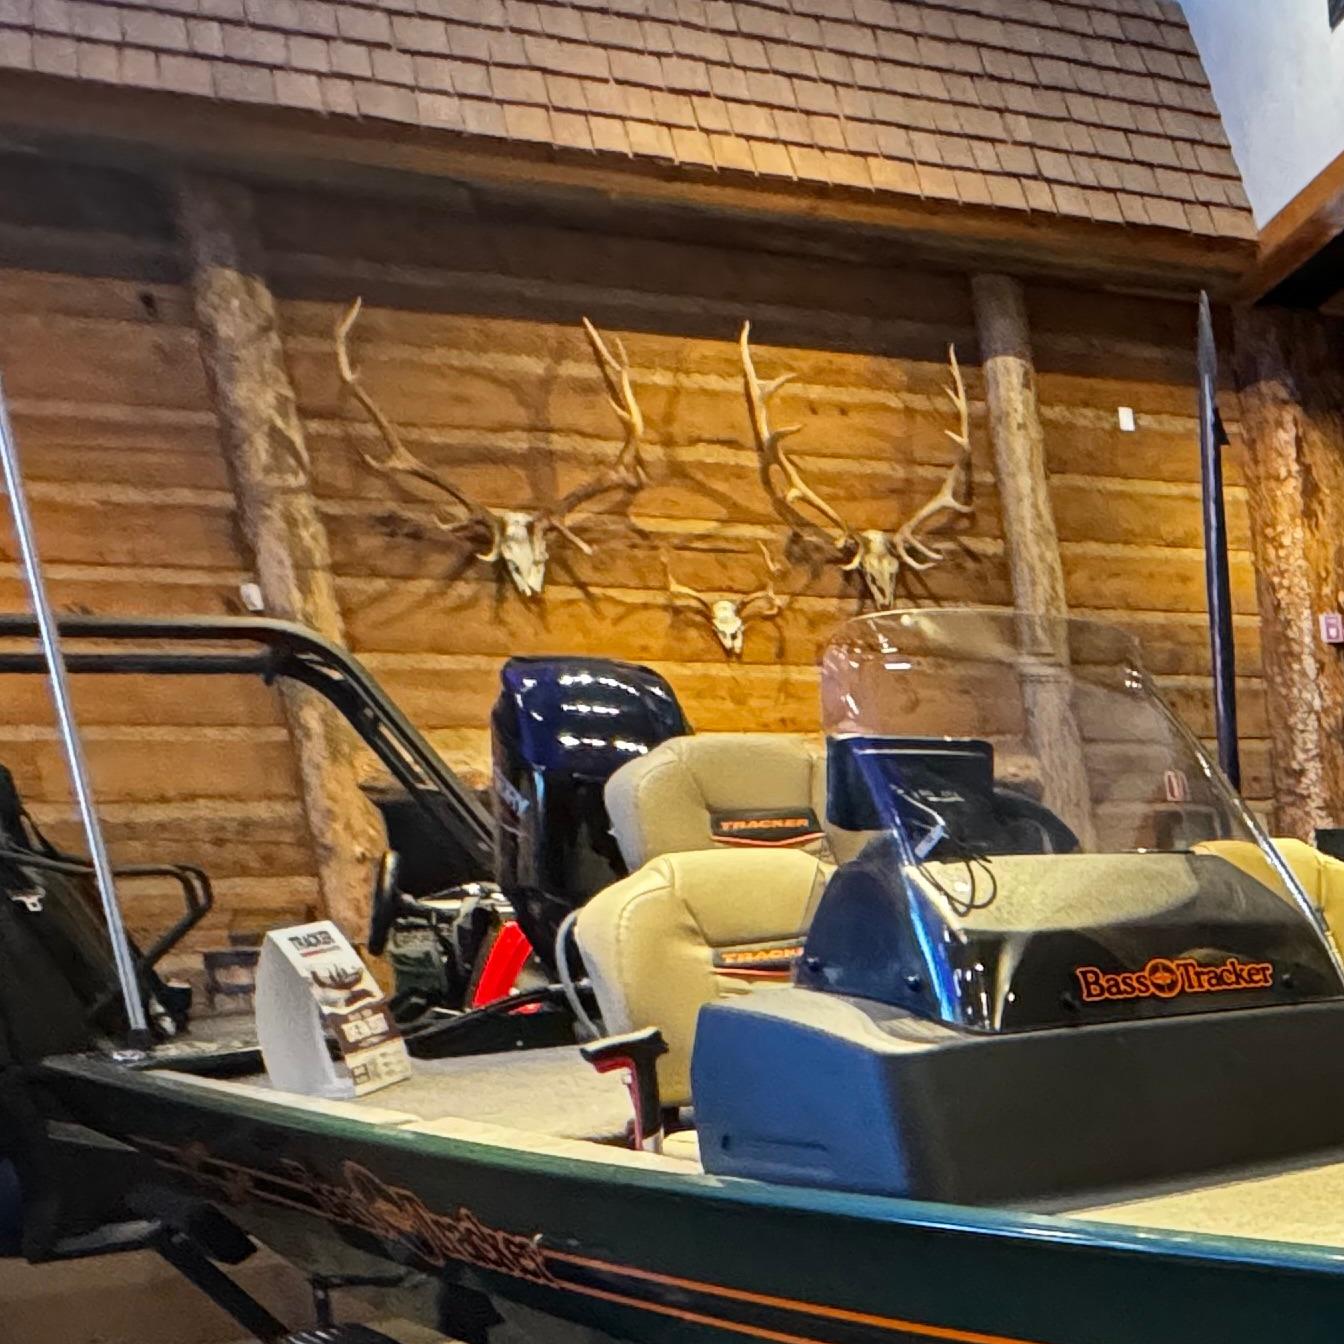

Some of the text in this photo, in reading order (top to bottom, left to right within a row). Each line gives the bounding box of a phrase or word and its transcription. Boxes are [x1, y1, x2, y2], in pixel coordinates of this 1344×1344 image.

[720, 818, 809, 831] TRACKER
[1077, 958, 1272, 1001] Bass Tracker
